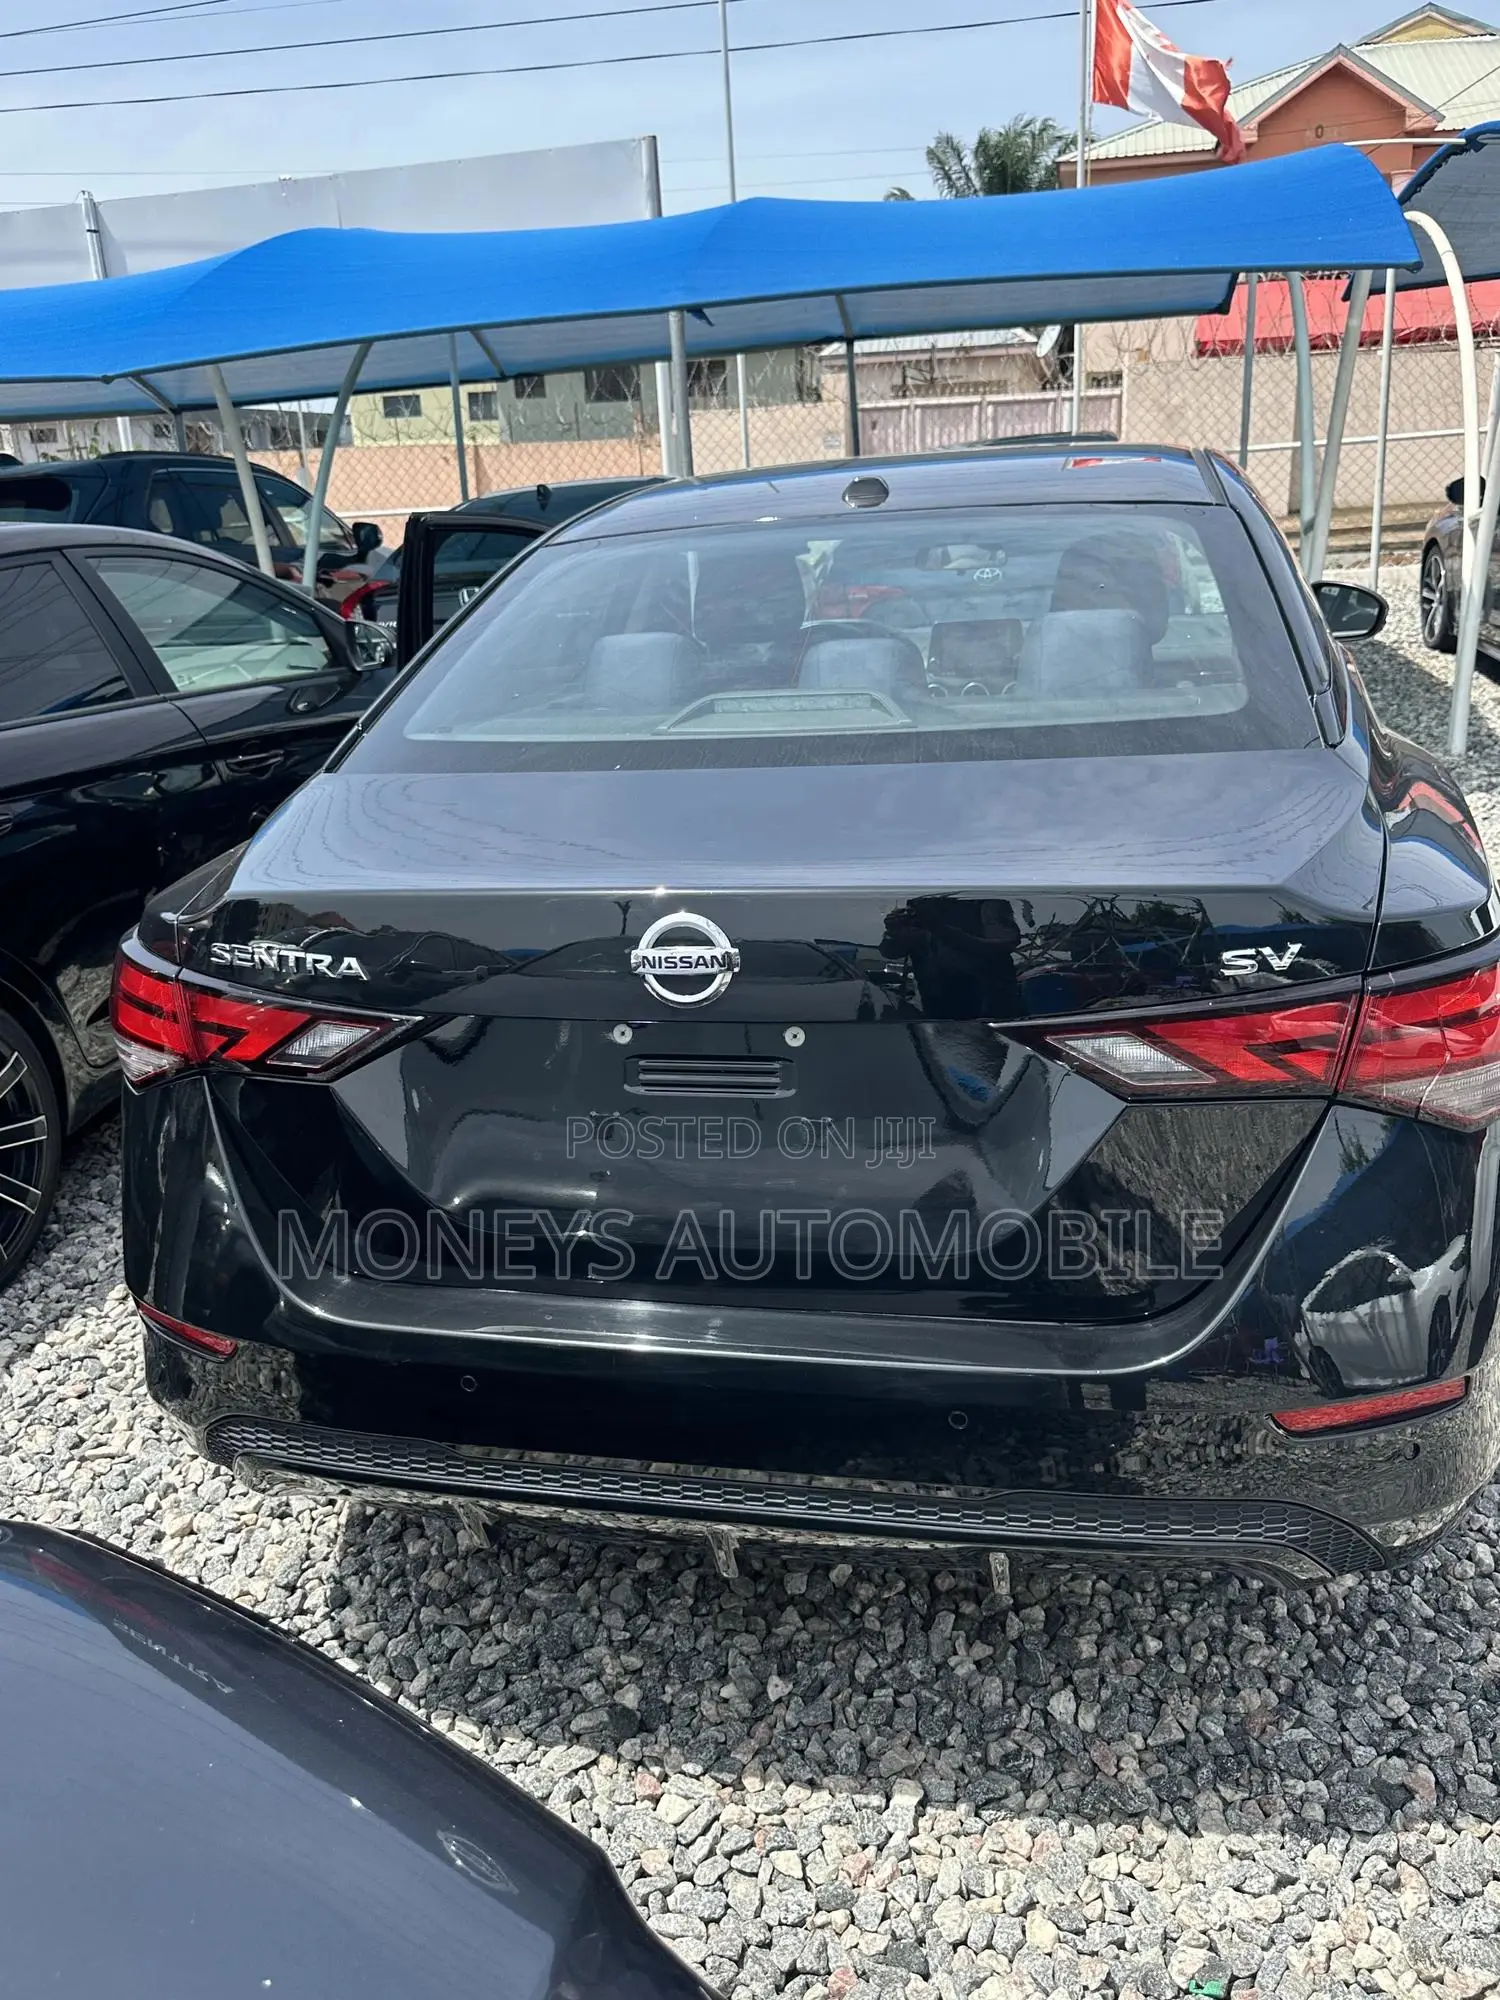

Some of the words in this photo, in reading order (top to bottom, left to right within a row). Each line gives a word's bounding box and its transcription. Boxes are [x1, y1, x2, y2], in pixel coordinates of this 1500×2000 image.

[210, 942, 369, 981] SENTRA
[641, 954, 727, 970] NISSAN
[1219, 942, 1302, 976] SV
